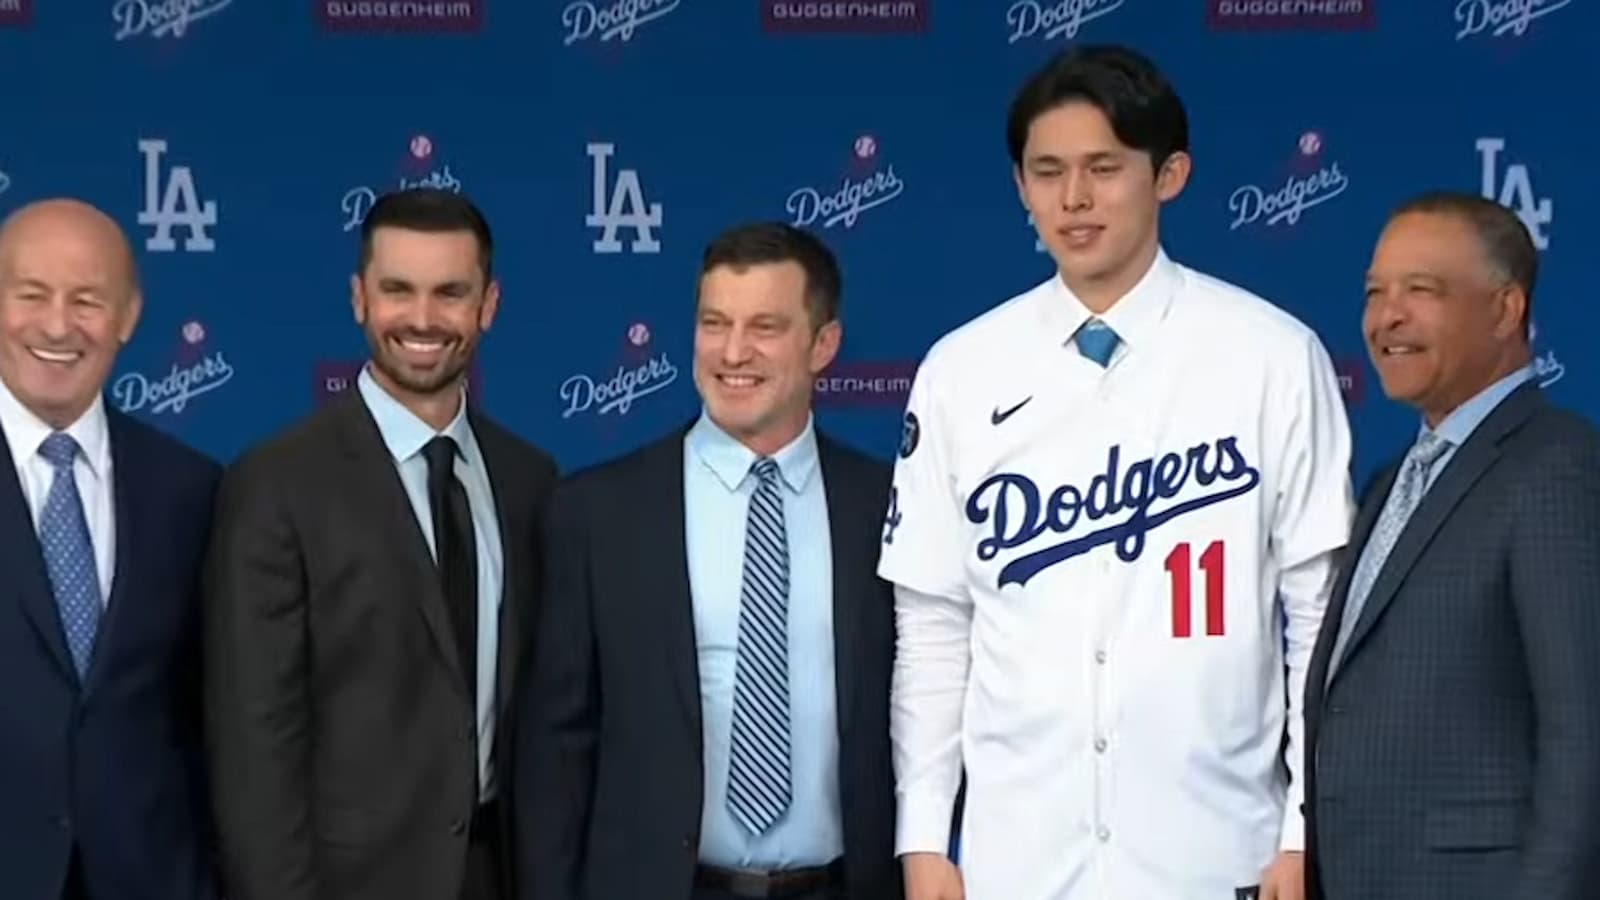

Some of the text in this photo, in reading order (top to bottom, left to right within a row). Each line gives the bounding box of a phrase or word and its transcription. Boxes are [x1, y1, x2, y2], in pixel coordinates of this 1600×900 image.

[327, 2, 470, 17] GUGGENHEIM
[773, 3, 916, 18] GUGGENHEIM
[137, 139, 217, 251] LA
[585, 143, 663, 253] LA
[786, 164, 904, 228] Dodgers
[1229, 161, 1349, 230] Dodgers
[112, 352, 234, 413] Dodgers
[560, 352, 678, 419] Dodgers
[815, 378, 911, 392] GENHEIM
[965, 436, 1260, 590] Dodgers
[1164, 540, 1225, 638] 11
